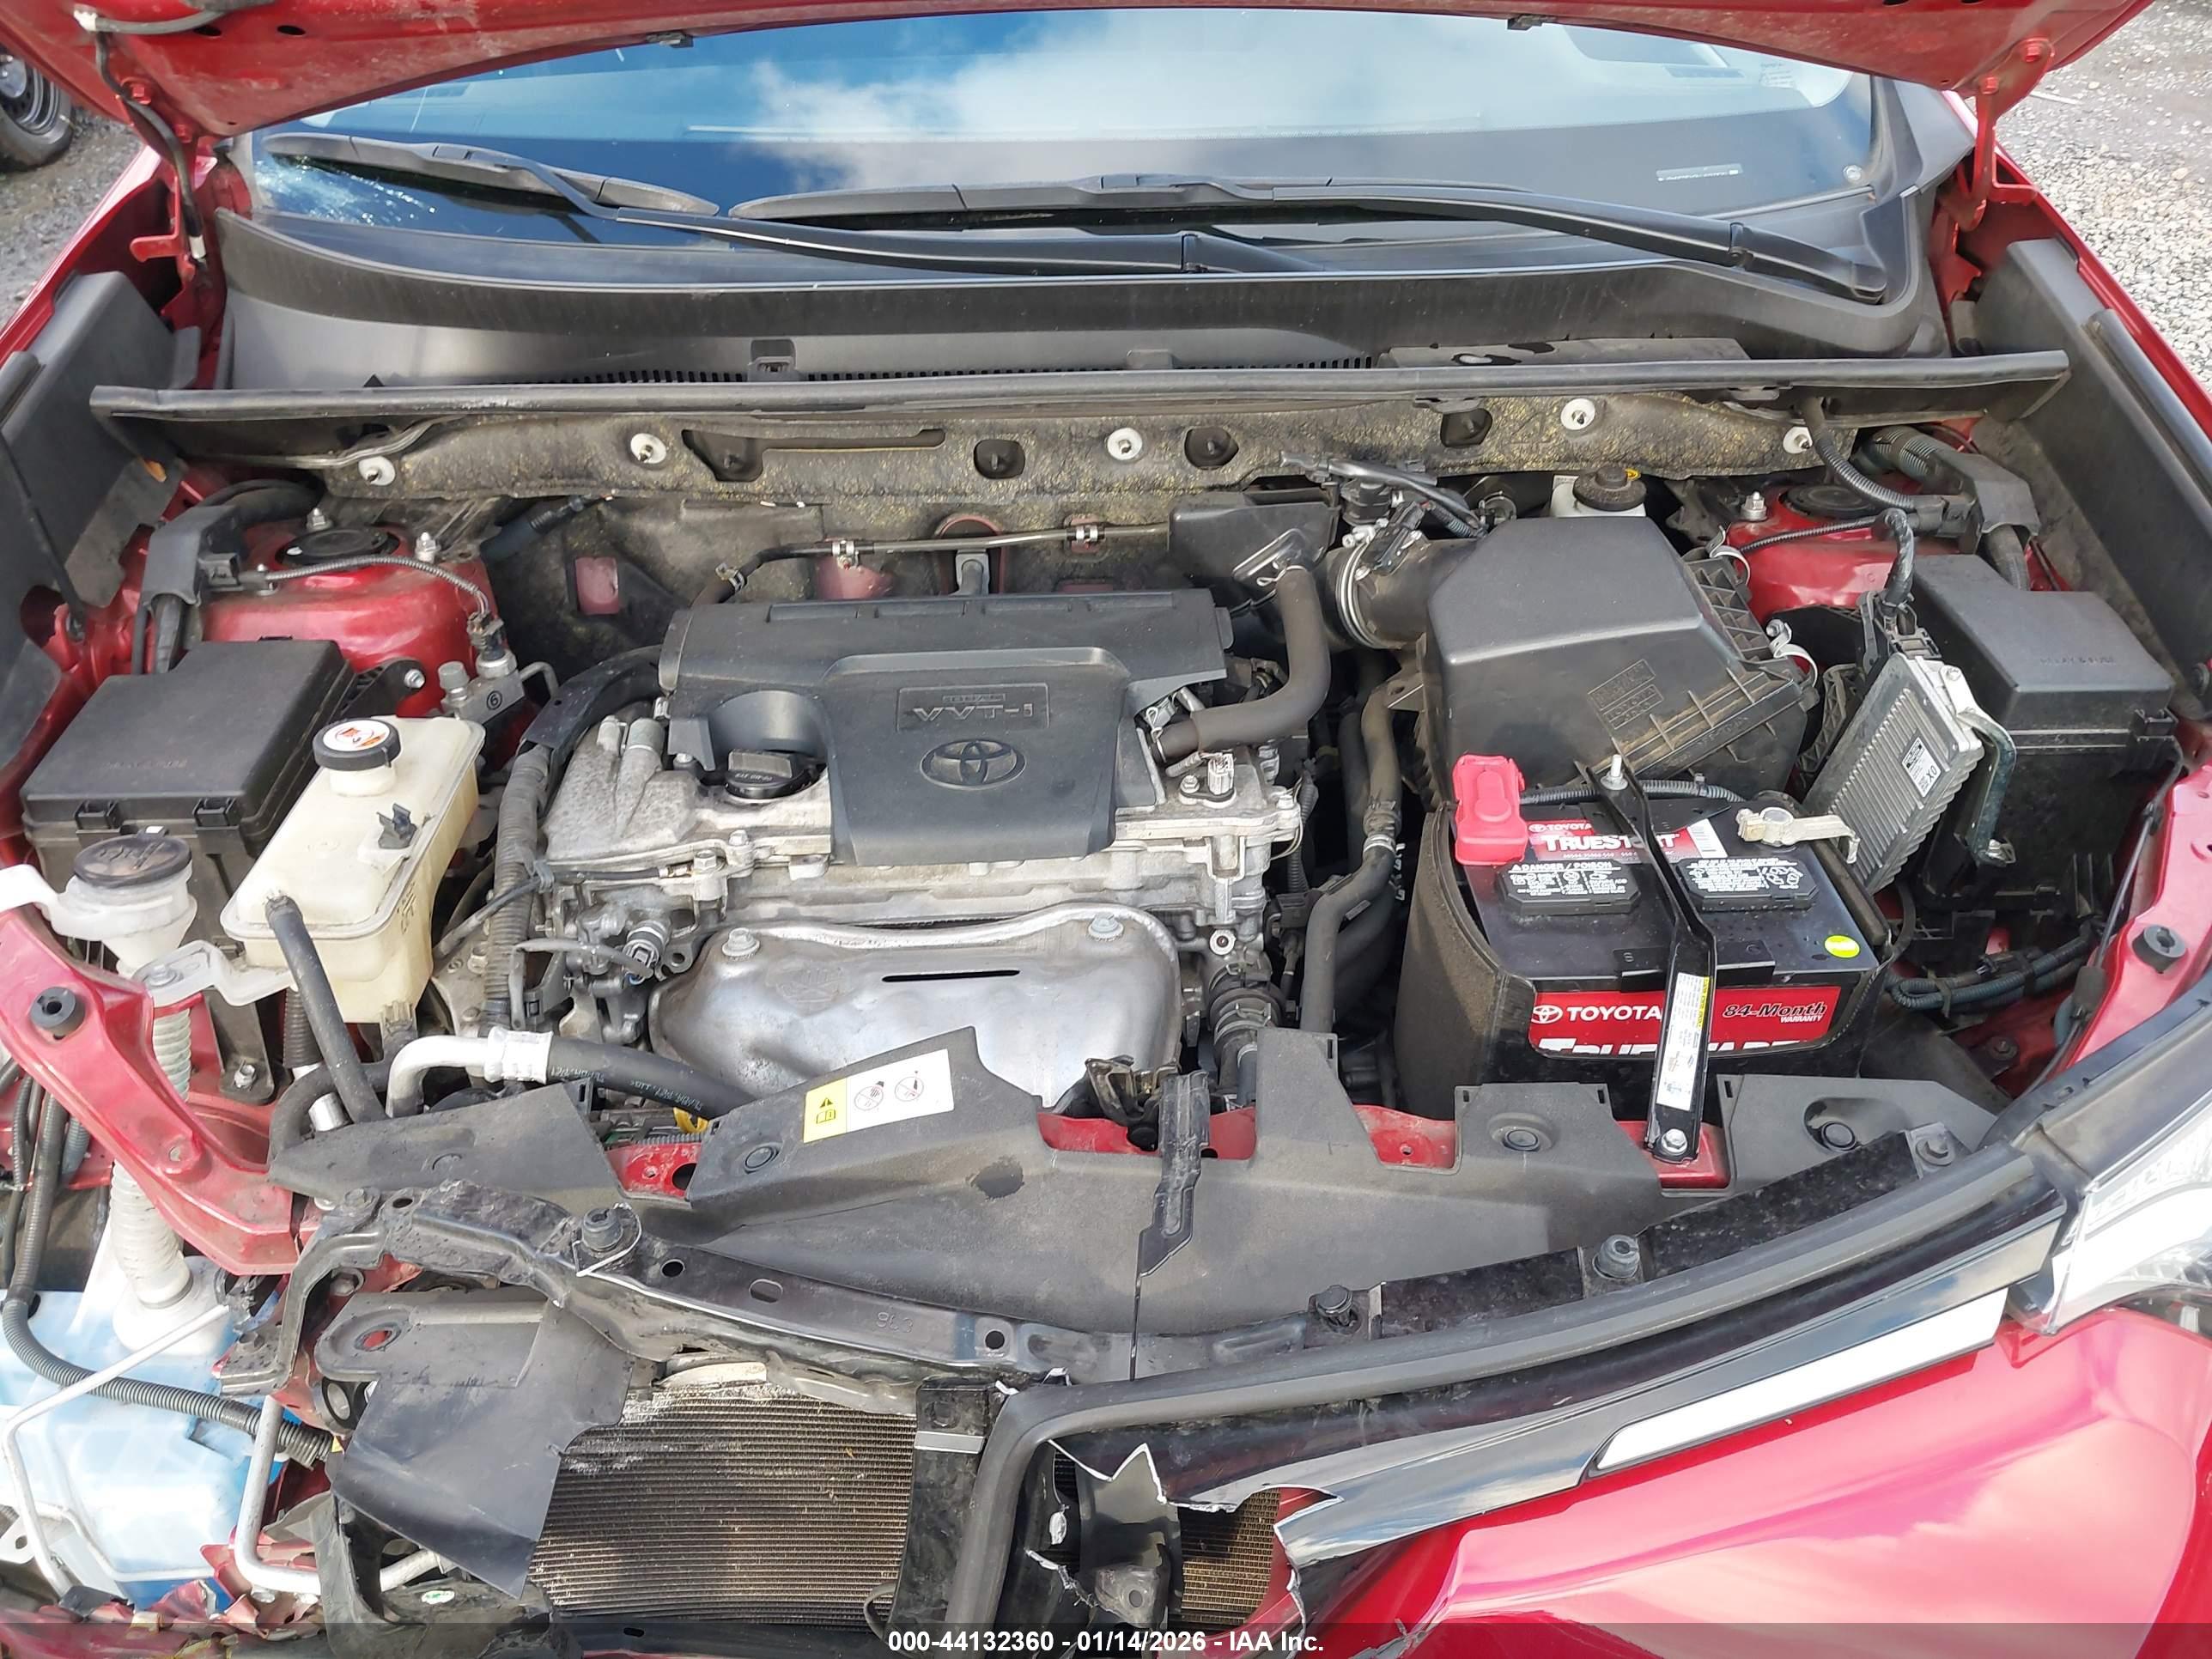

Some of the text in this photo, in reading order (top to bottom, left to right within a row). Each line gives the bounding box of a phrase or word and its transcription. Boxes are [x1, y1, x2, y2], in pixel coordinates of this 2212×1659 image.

[1522, 862, 1565, 872] DANGER
[1573, 861, 1613, 871] POISON
[1566, 1006, 1662, 1022] TOYOTA
[1723, 1001, 1828, 1018] 84-Month
[1779, 1015, 1823, 1024] WARRANTY
